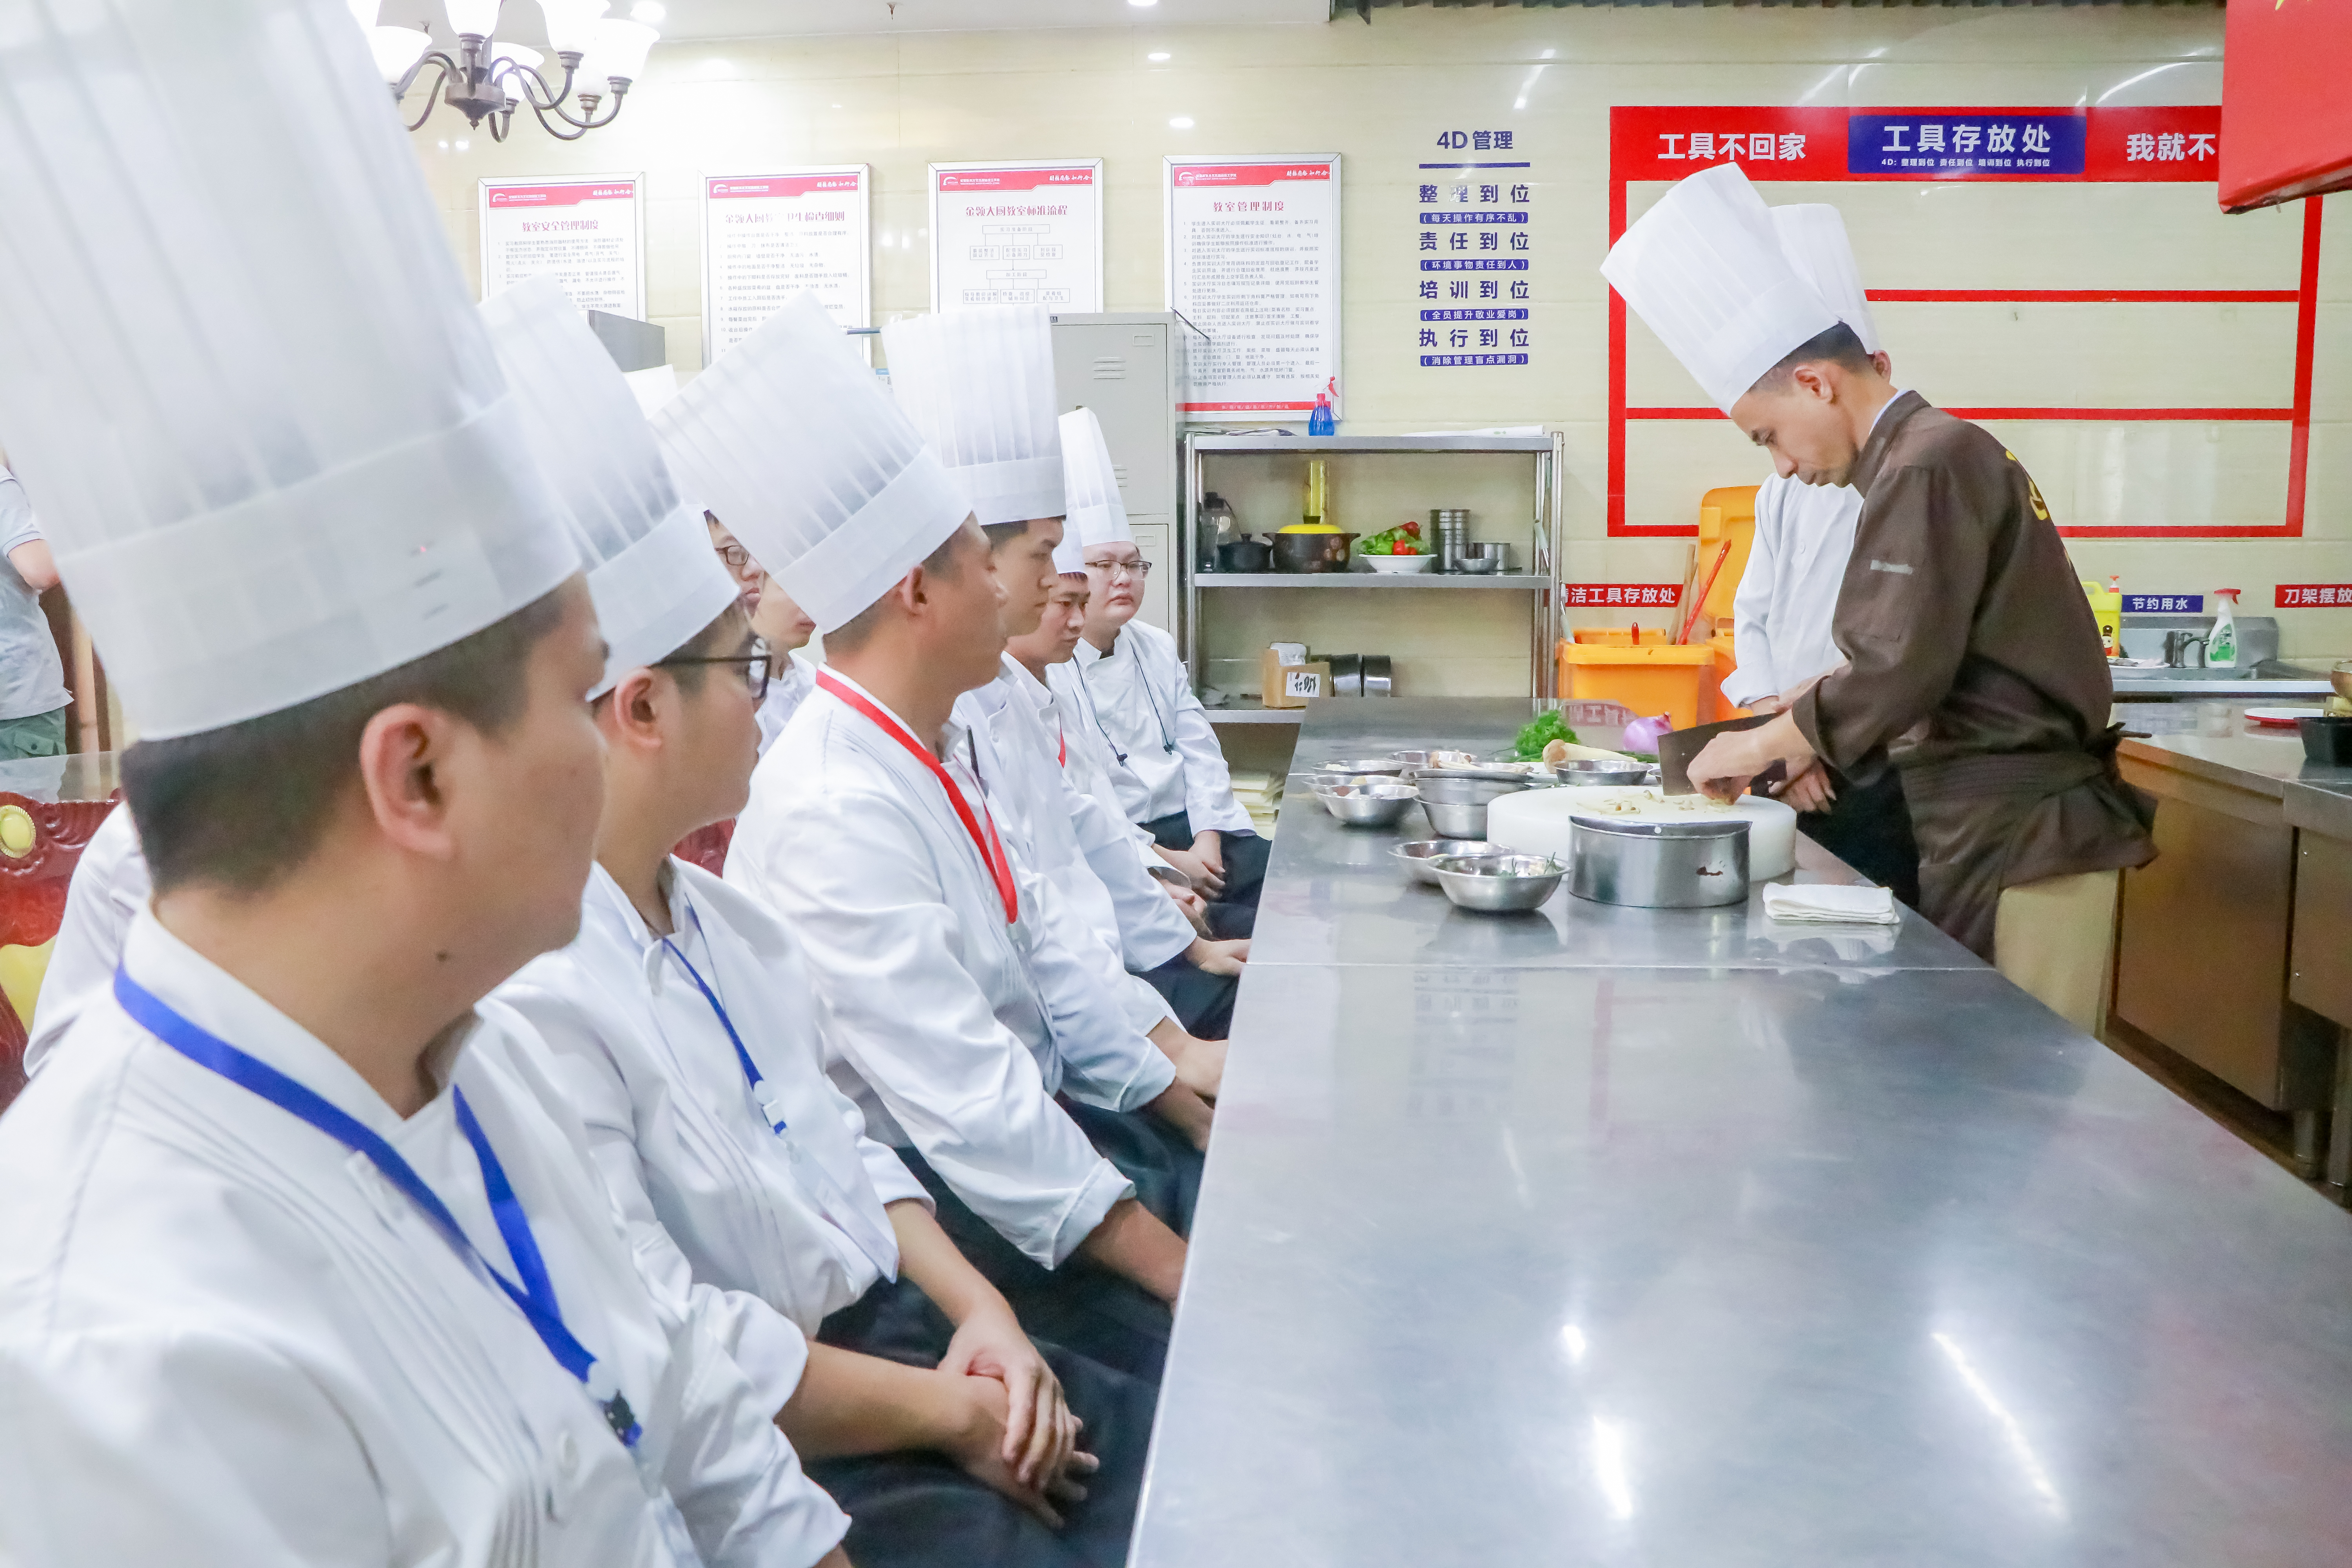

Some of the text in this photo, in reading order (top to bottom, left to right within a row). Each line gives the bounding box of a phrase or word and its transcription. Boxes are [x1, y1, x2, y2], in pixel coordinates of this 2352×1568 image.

[1437, 131, 1513, 150] 4D管理
[1658, 133, 1806, 160] 工具不回家
[1882, 124, 2051, 153] 工具存放处
[2127, 132, 2216, 161] 我就不
[1901, 158, 1935, 167] 整理到位
[1939, 158, 1973, 167] 责任到位
[1978, 158, 2012, 167] 培训到位
[2016, 158, 2050, 167] 执行到位
[1419, 184, 1530, 203] 整理到位
[965, 205, 1067, 216] 金领大厨教室标准流程
[1214, 201, 1285, 212] 教室管理制度
[726, 211, 844, 223] 金领大厨教卫生检查细则
[523, 220, 599, 232] 教室安全管理制度
[1419, 232, 1529, 250] 责任到位
[1419, 280, 1529, 299] 培训到位
[1419, 328, 1529, 347] 执行到位
[1566, 587, 1675, 603] 洁工具存放处
[2132, 597, 2188, 610] 节约用水
[2284, 588, 2352, 604] 刀架摆放
